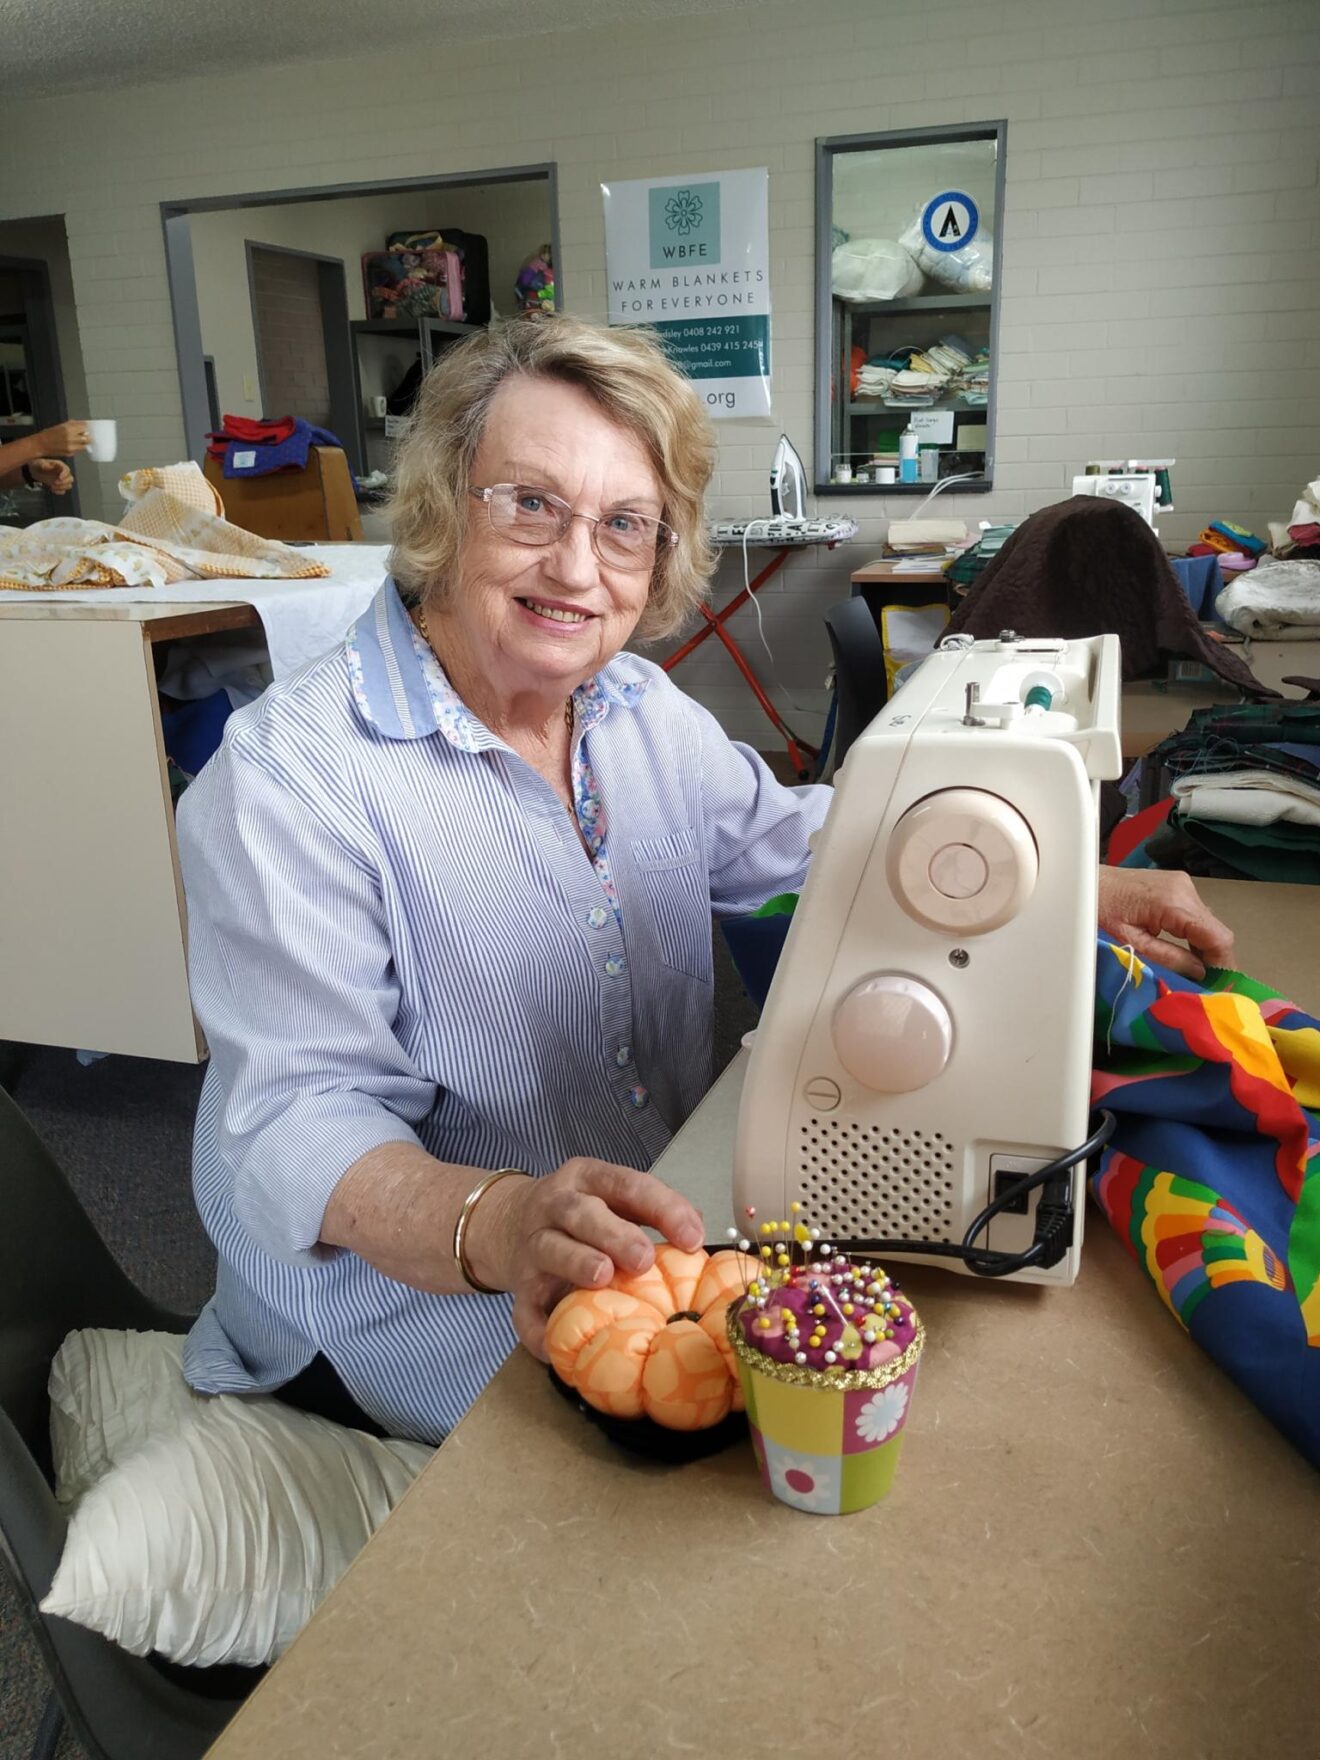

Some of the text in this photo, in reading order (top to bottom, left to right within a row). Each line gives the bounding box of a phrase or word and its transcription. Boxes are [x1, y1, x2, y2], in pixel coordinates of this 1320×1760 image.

[662, 243, 708, 259] WBFE
[612, 270, 764, 292] WARM BLANKETS
[621, 292, 755, 313] FOR EVERYONE
[661, 325, 740, 339] dsley 0408 242 921
[700, 343, 721, 352] 0439
[723, 341, 740, 351] 415
